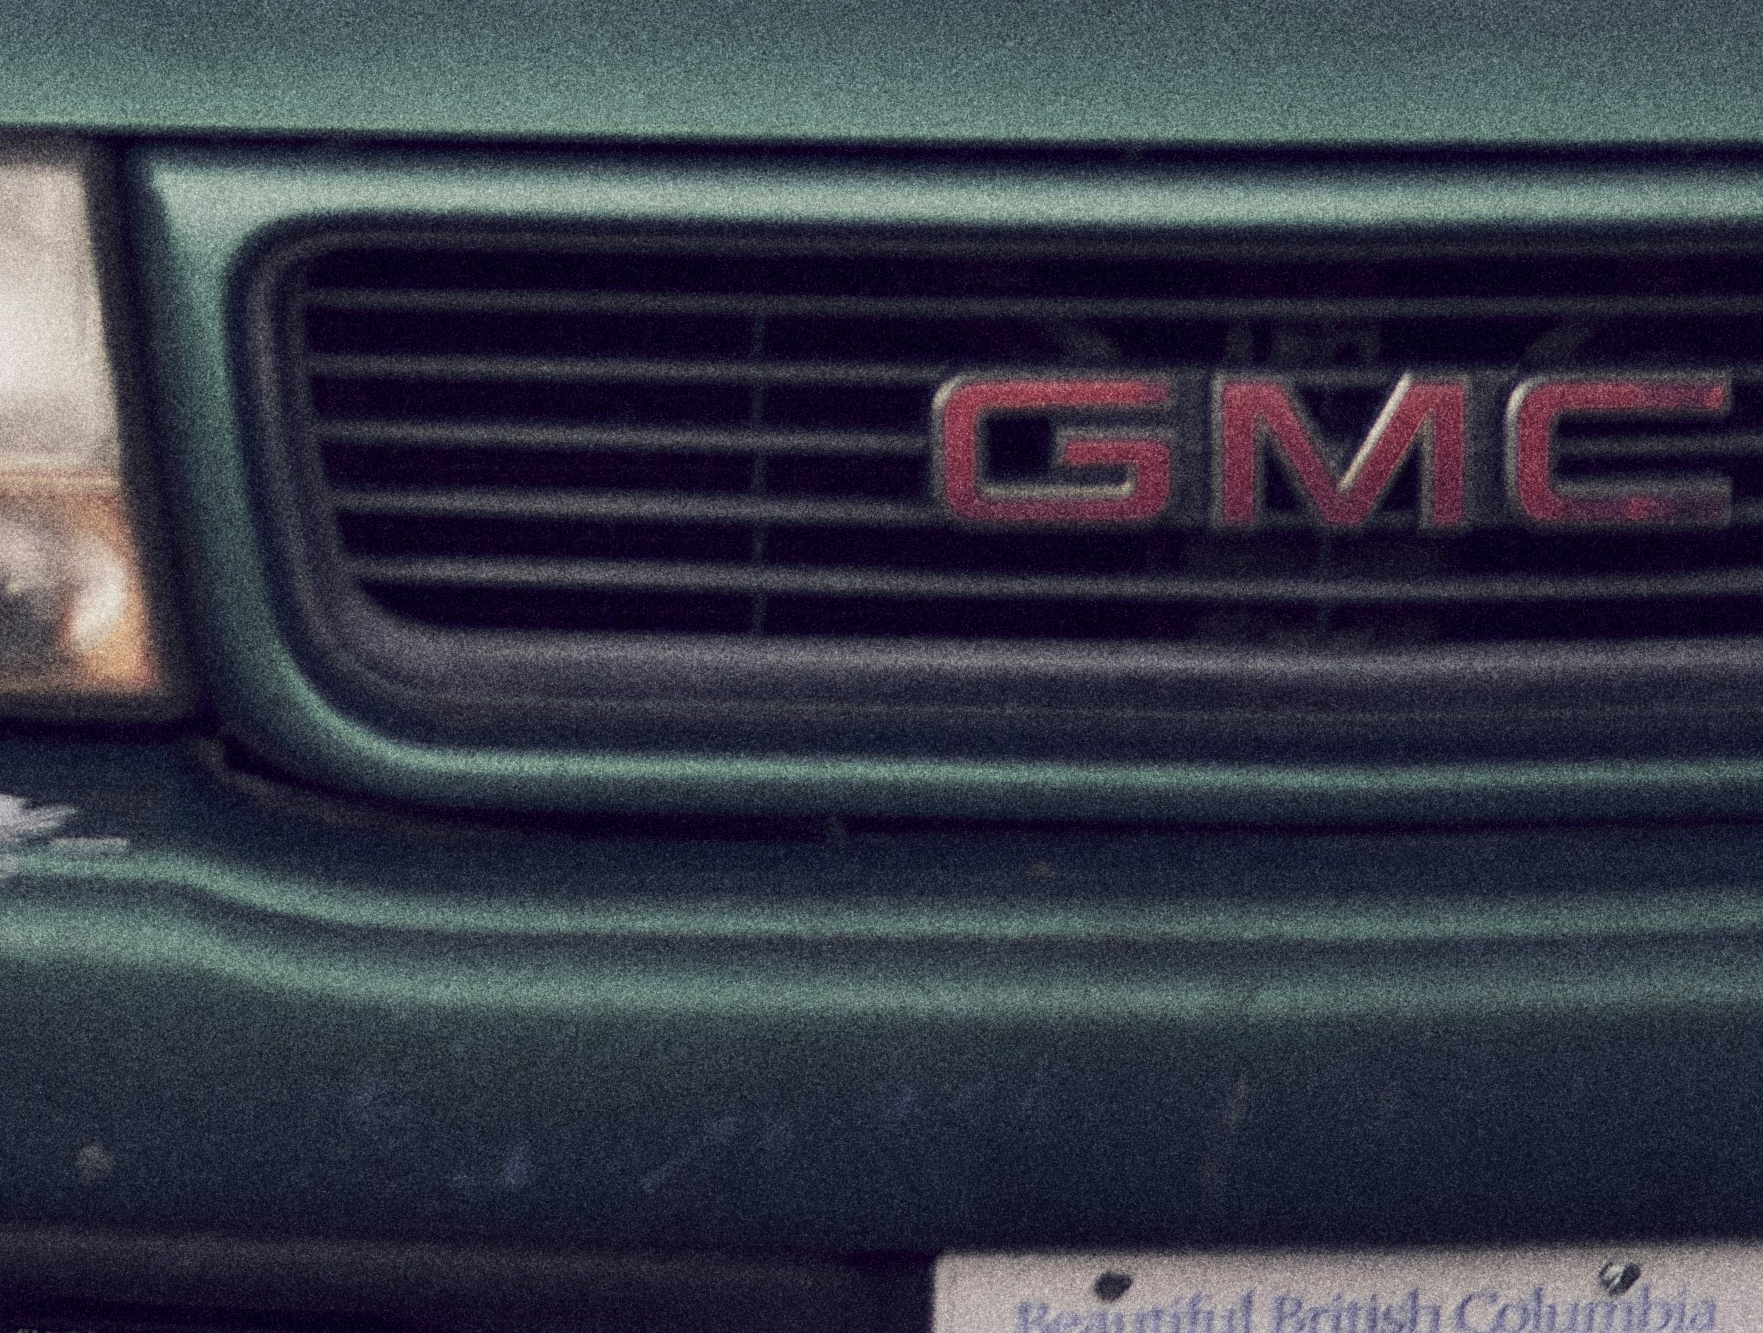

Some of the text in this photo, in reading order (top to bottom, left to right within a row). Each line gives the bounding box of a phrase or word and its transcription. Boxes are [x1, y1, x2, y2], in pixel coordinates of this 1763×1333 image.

[932, 371, 1732, 530] GMC
[1016, 1284, 1717, 1333] Beautiful British Columbia
